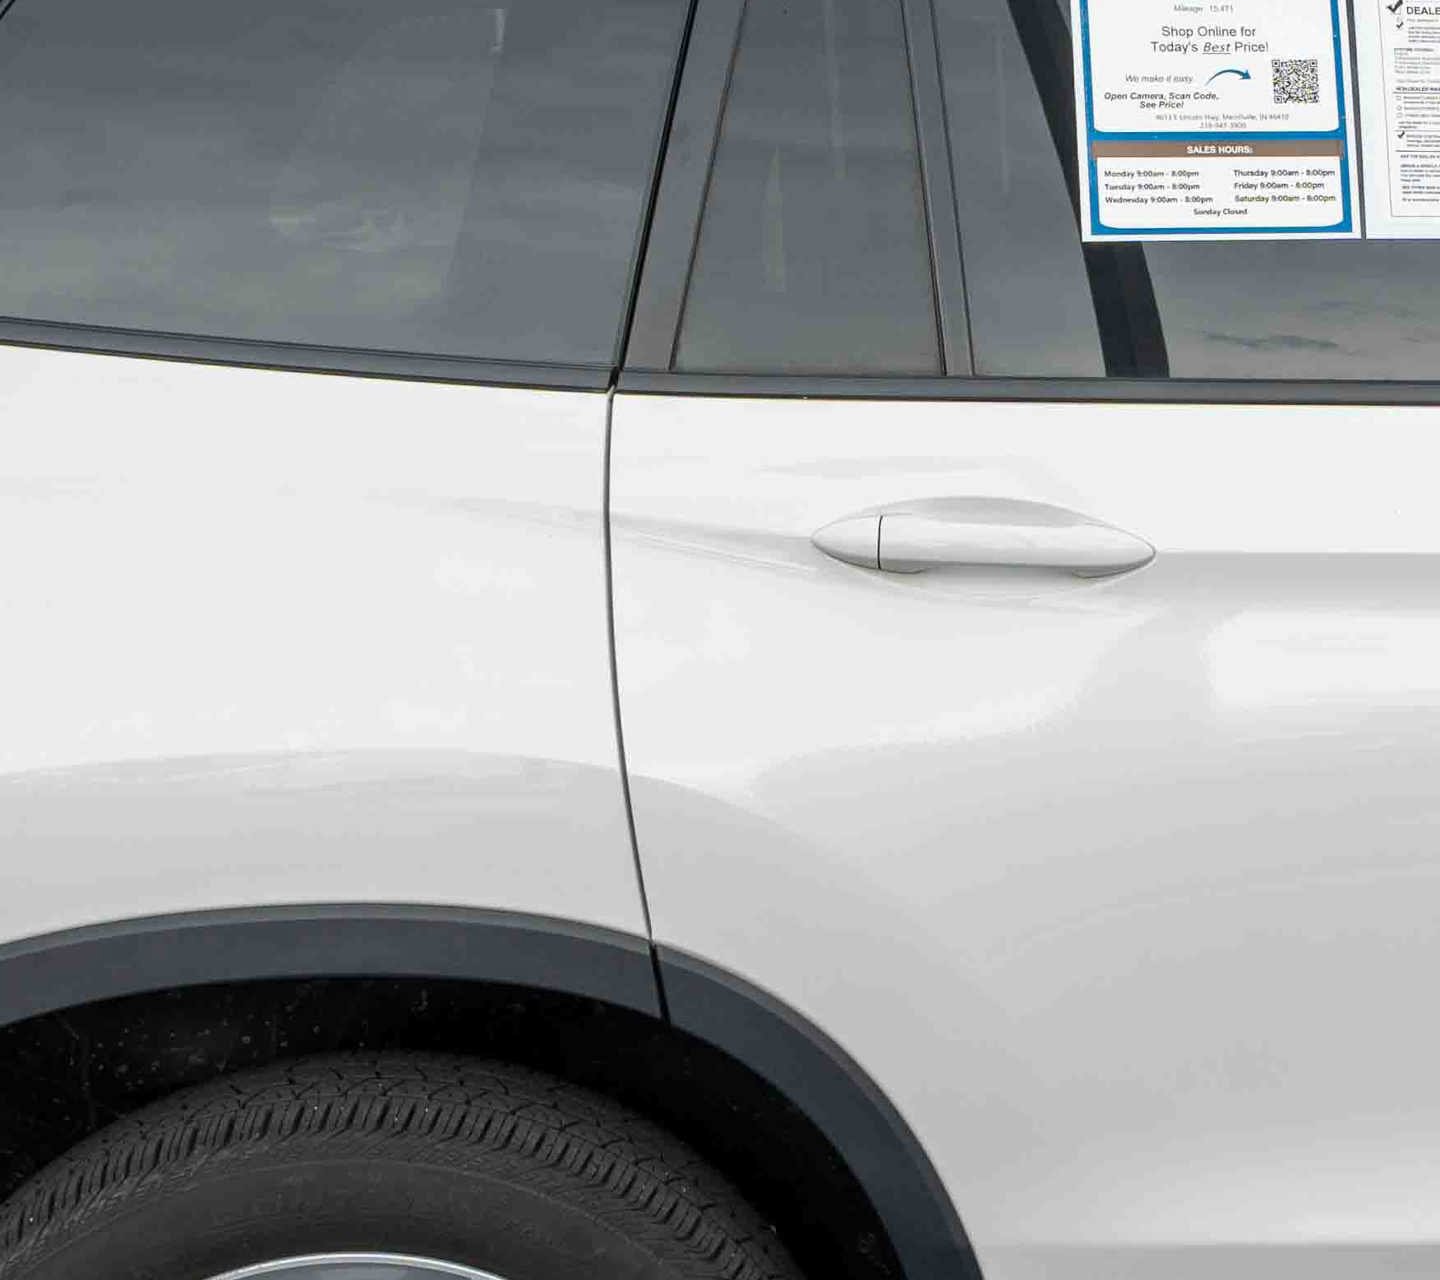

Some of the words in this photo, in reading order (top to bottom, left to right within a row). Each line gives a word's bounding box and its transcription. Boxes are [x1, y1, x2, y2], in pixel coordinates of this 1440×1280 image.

[1161, 26, 1194, 39] Shop
[1197, 26, 1237, 37] Online
[1240, 26, 1257, 37] for
[1150, 42, 1199, 55] Today's
[1203, 43, 1231, 53] Best
[1234, 42, 1270, 53] Price!
[1104, 92, 1128, 101] Open
[1168, 92, 1191, 101] Scan
[1139, 101, 1157, 109] See
[1159, 101, 1185, 109] Price!
[1186, 145, 1217, 154] SALES
[1218, 146, 1253, 154] HOURS:
[1104, 170, 1135, 178] Monday
[1233, 169, 1269, 177] Thursday
[1234, 182, 1259, 190] Friday
[1235, 195, 1270, 204] Saturday
[1193, 208, 1221, 217] Sunday
[1222, 207, 1248, 215] Closed
